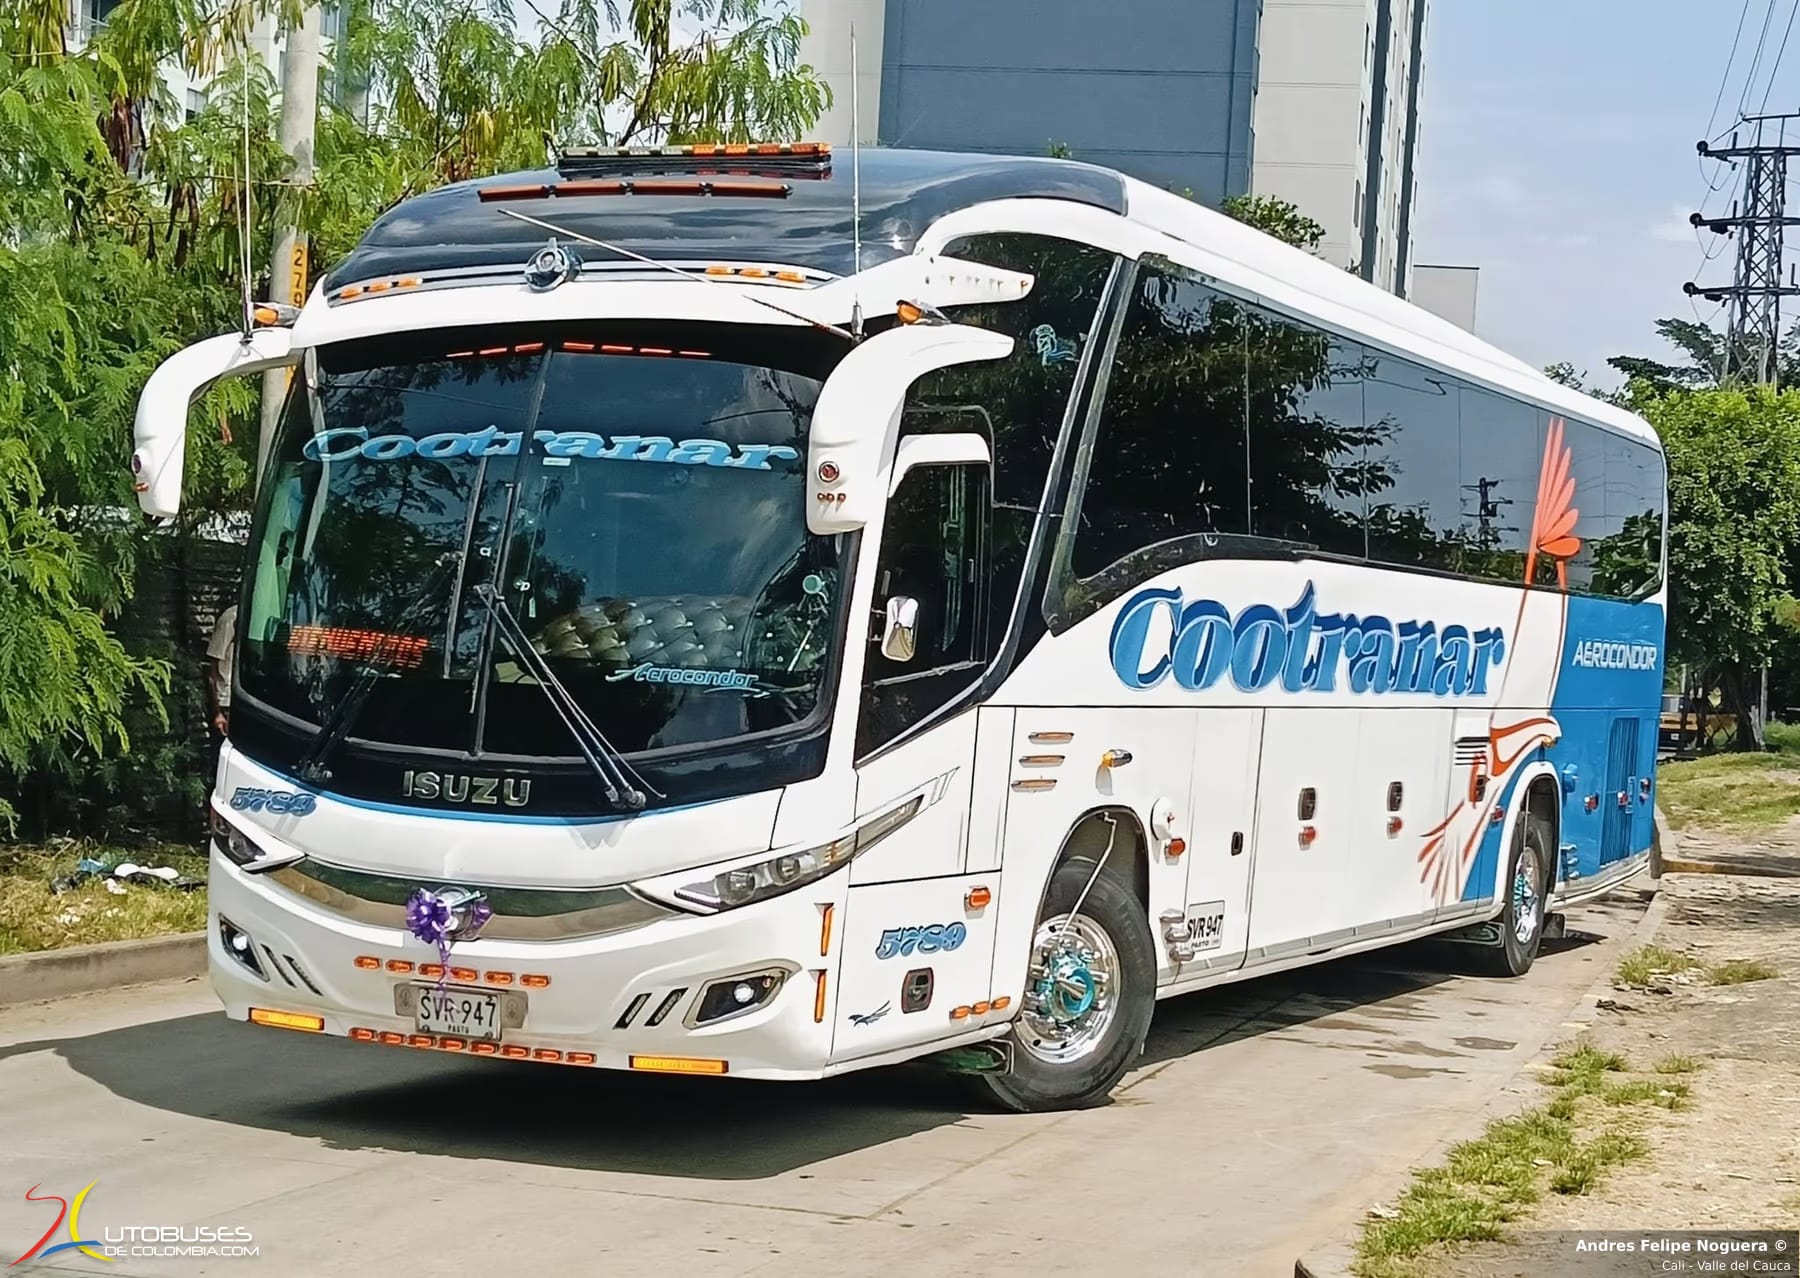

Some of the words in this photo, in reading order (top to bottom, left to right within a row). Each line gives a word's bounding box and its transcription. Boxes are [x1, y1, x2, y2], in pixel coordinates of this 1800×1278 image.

[303, 425, 798, 470] Cootranar
[1109, 580, 1505, 697] Cootranar
[1572, 639, 1657, 670] AEROCONDOR
[230, 787, 317, 817] 5789
[402, 770, 531, 807] ISUZU
[875, 921, 967, 960] 5789
